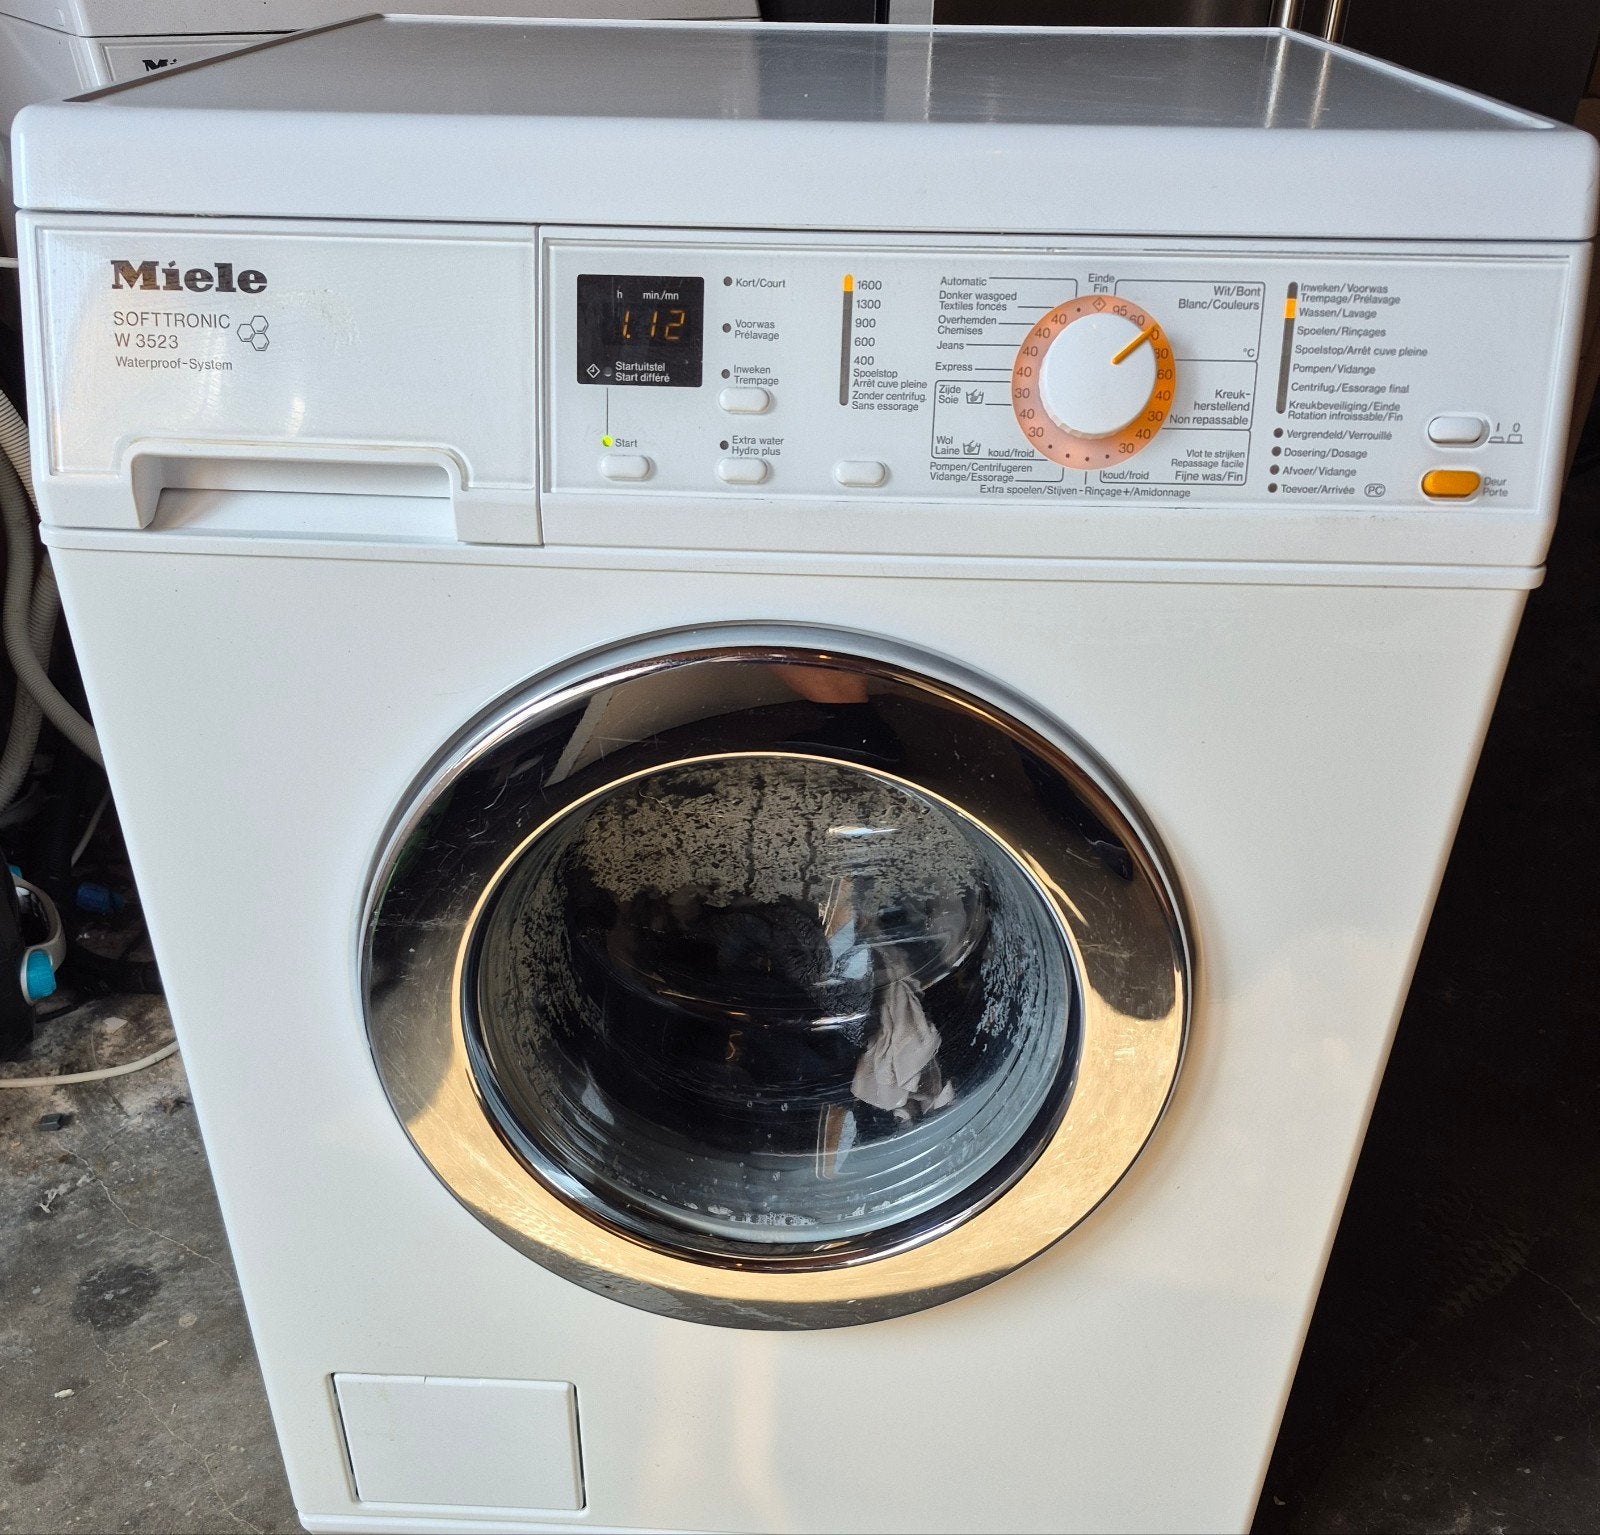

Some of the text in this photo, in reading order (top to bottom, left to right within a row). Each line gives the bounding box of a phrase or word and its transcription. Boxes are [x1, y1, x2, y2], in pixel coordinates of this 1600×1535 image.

[111, 260, 267, 293] Miele
[940, 277, 987, 286] Automatic
[1088, 273, 1115, 283] Einde
[736, 278, 786, 288] Kort/Court
[857, 281, 882, 290] 1600
[1093, 284, 1108, 292] Fin
[1301, 283, 1388, 293] Inweken/Voorwas
[617, 290, 622, 299] h
[939, 291, 1017, 301] Donker wasgoed
[1213, 285, 1261, 297] Wit/Bont
[856, 300, 881, 309] 1300
[940, 301, 1007, 311] Textiles foncés
[1178, 299, 1259, 310] Blanc/Couleurs
[1113, 305, 1127, 316] 95
[1299, 308, 1377, 319] Wassen/Lavage
[113, 311, 230, 329] SOFTTRONIC
[735, 320, 775, 329] Voorwas
[855, 318, 876, 328] 900
[938, 315, 997, 325] Overhemden
[1051, 314, 1067, 325] 40
[735, 330, 779, 340] Prélavage
[937, 326, 983, 335] Chemises
[1035, 328, 1051, 338] 40
[1297, 326, 1386, 338] Spoelen/Rinçages
[115, 333, 178, 349] W 3523
[855, 337, 875, 347] 600
[937, 341, 964, 350] Jeans
[1023, 347, 1038, 357] 40
[1373, 348, 1396, 356] cuve
[1398, 349, 1428, 357] pleine
[115, 356, 233, 371] Waterproof-System
[854, 356, 874, 365] 400
[615, 362, 665, 372] Startuitstel
[733, 365, 770, 374] Inweken
[935, 362, 973, 373] Express
[1016, 367, 1032, 377] 40
[1293, 364, 1375, 375] Pompen/Vidange
[615, 373, 670, 382] Start différé
[853, 369, 898, 378] Spoelstop
[1157, 369, 1172, 379] 60
[735, 376, 779, 386] Trempage
[853, 379, 875, 387] Arrêt
[901, 380, 927, 389] pleine
[939, 385, 961, 395] Zijde
[1015, 388, 1030, 398] 30
[1389, 385, 1409, 393] final
[852, 391, 883, 400] Zonder
[939, 395, 958, 404] Soie
[1156, 390, 1170, 400] 40
[1215, 390, 1251, 399] Kreuk-
[852, 401, 918, 412] Sans essorage
[1194, 401, 1250, 411] herstellend
[1289, 401, 1400, 412] Kreukbeveiliging/Einde
[1019, 409, 1035, 419] 40
[1148, 411, 1163, 422] 30
[1288, 410, 1403, 422] Rotation infroissable/Fin
[1170, 414, 1248, 426] Non repassable
[1028, 427, 1044, 437] 30
[1135, 430, 1151, 439] 40
[1287, 430, 1393, 440] Vergrendeld/Verrouillé
[615, 439, 637, 448] Start
[732, 436, 755, 445] Extra
[936, 436, 953, 445] Wol
[732, 446, 781, 456] Hydro plus
[936, 445, 960, 455] Laine
[988, 448, 1034, 458] koud/froid
[1119, 444, 1135, 453] 30
[1186, 449, 1203, 458] Vlot
[1214, 450, 1245, 459] strijken
[1284, 448, 1368, 460] Dosering/Dosage
[930, 462, 1032, 473] Pompen/Centrifugeren
[1171, 459, 1244, 469] Repassage facile
[930, 472, 1014, 482] Vidange/Essorage
[1103, 470, 1149, 481] koud/froid
[1175, 471, 1243, 482] Fijne was/Fin
[1283, 466, 1356, 478] Afvoer/Vidange
[1484, 477, 1507, 486] Deur
[980, 485, 1004, 494] Extra
[1281, 484, 1355, 494] Toevoer/Arrivée
[1368, 486, 1382, 495] PC
[1483, 488, 1508, 496] Porte
